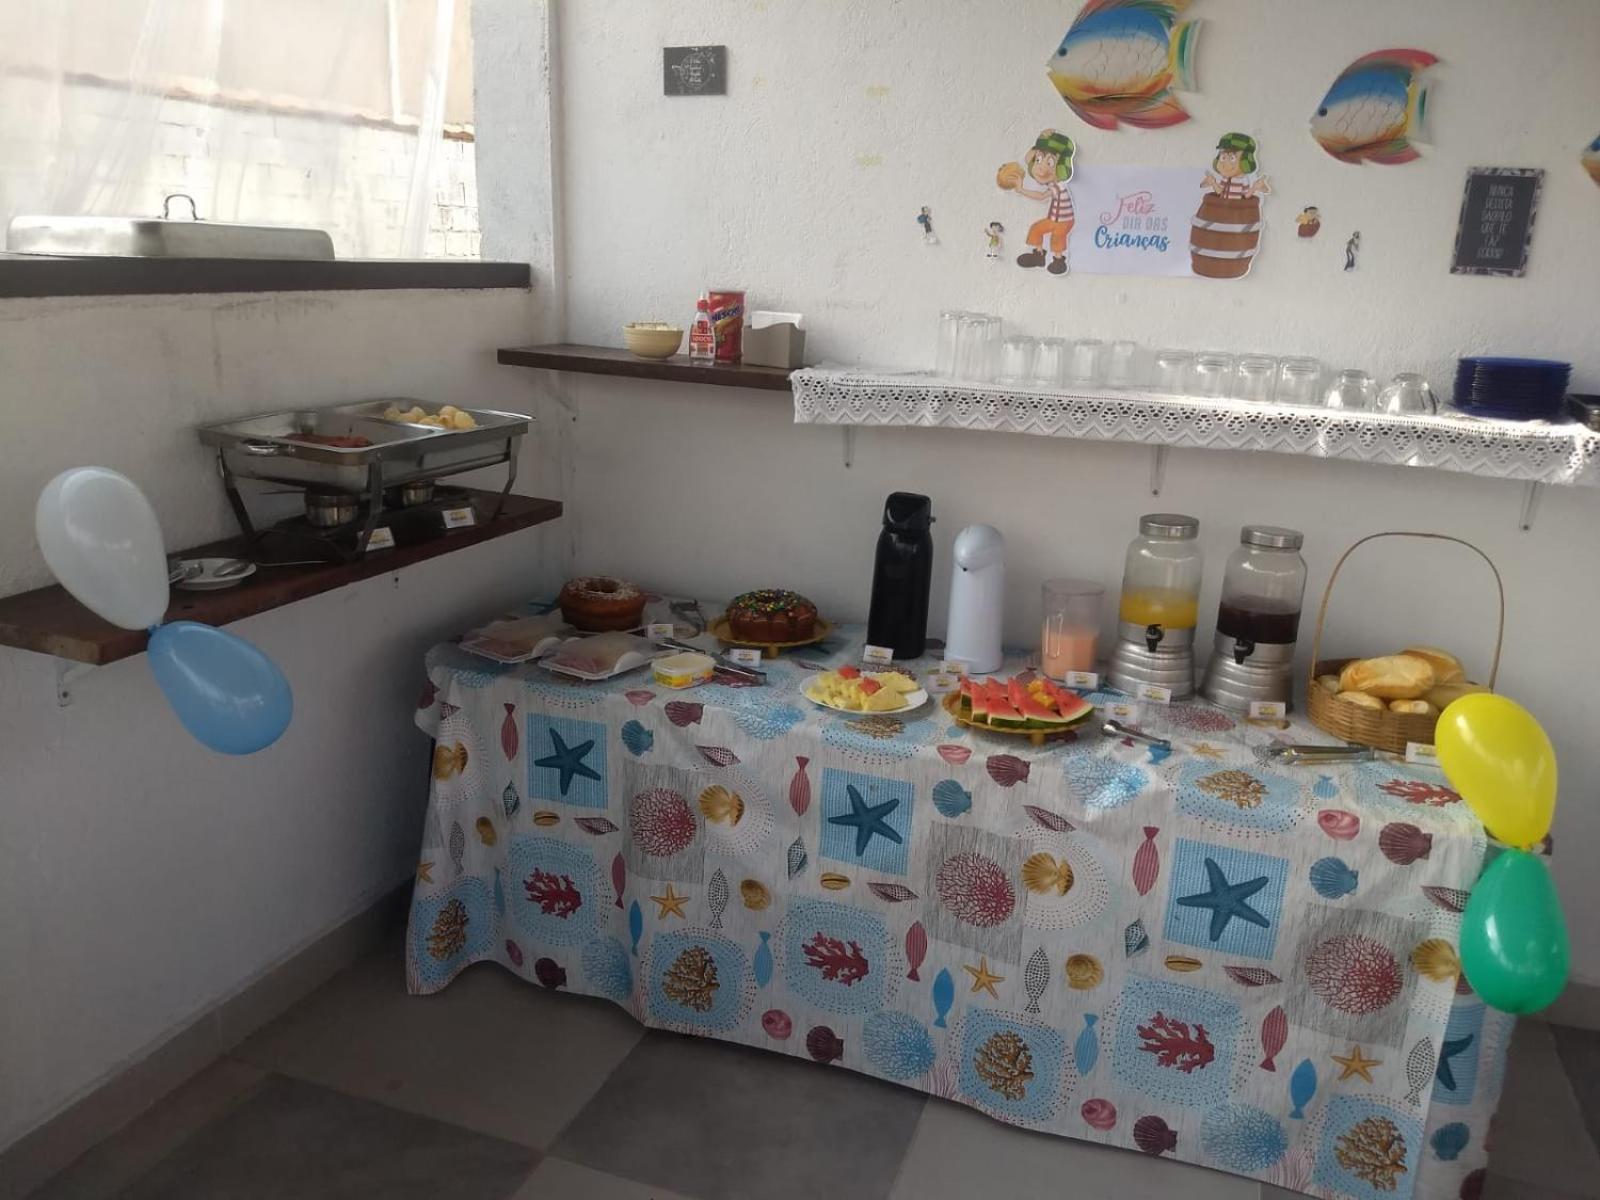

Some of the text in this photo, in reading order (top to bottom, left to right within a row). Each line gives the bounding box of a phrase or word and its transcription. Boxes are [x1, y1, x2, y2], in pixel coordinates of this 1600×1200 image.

[1100, 191, 1155, 225] Feliz
[1122, 216, 1169, 232] DIA DAS
[1095, 225, 1170, 252] Crianças
